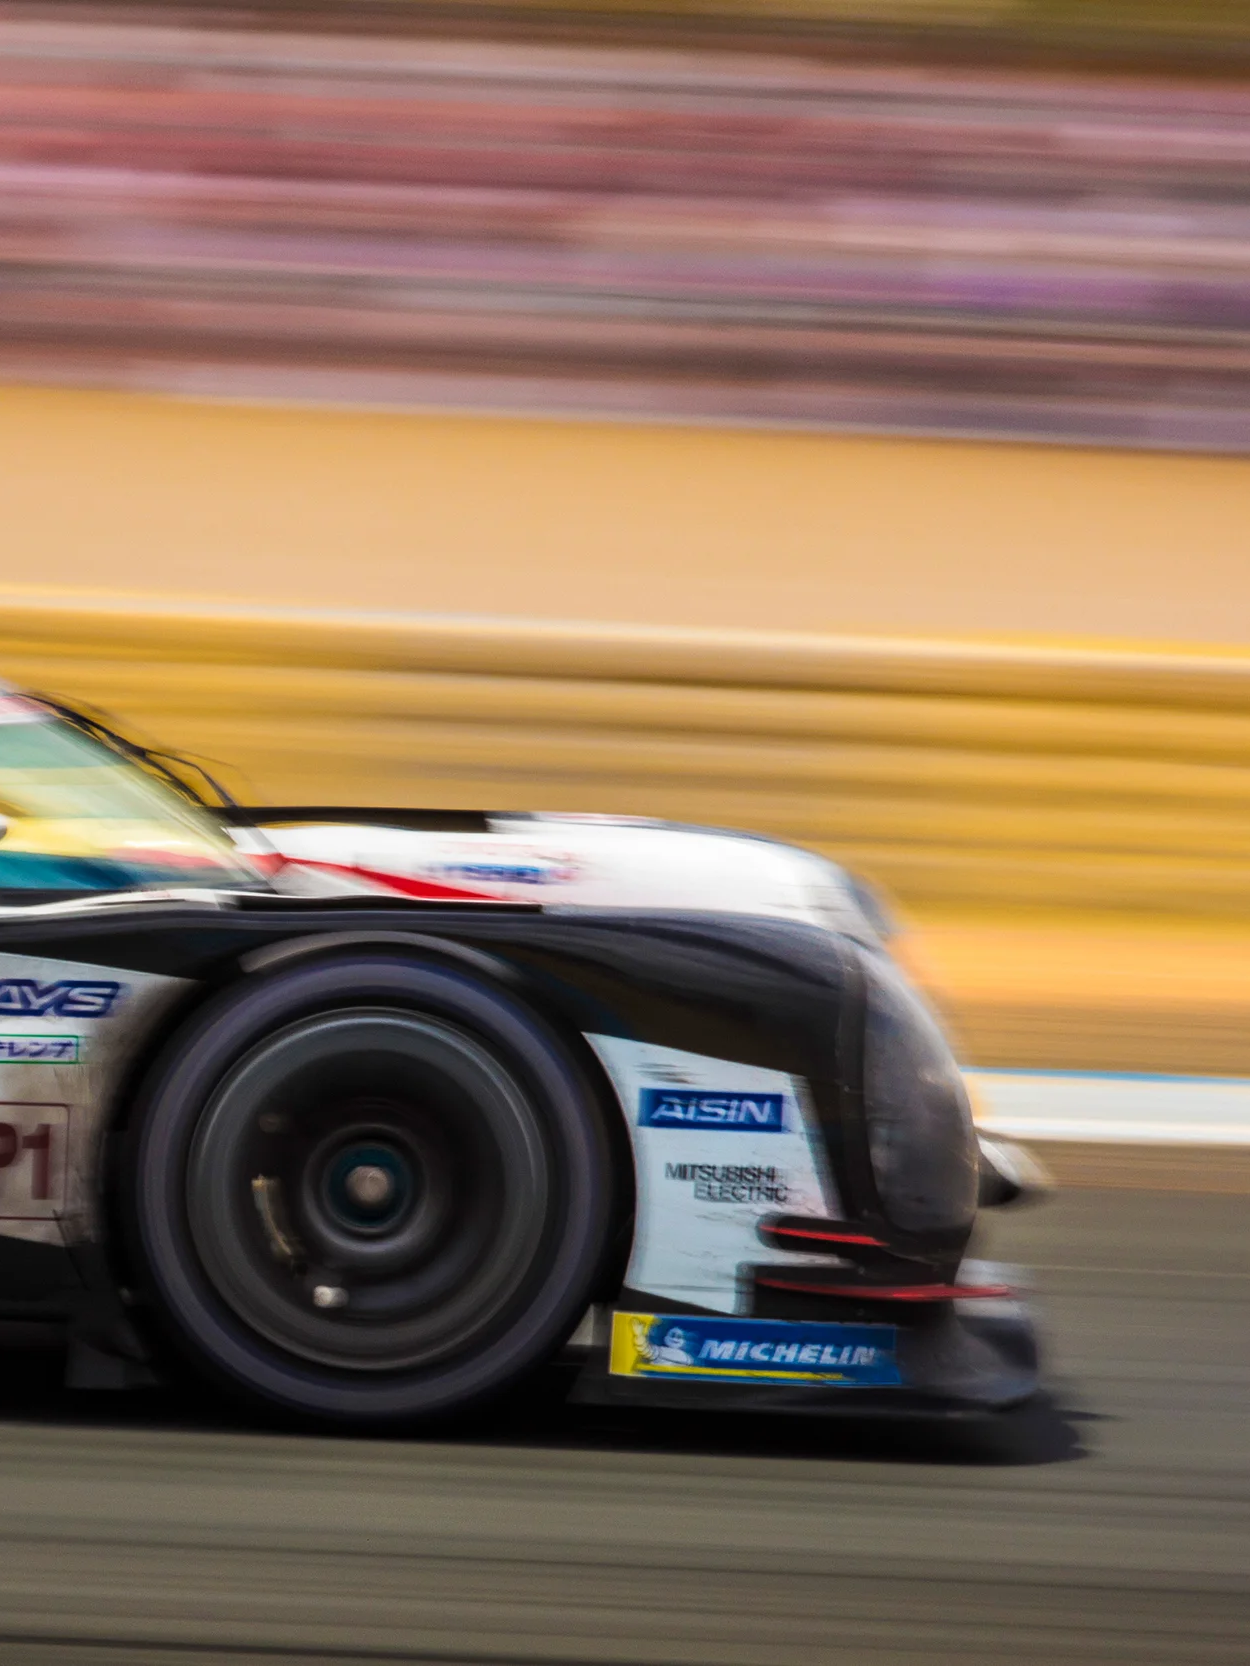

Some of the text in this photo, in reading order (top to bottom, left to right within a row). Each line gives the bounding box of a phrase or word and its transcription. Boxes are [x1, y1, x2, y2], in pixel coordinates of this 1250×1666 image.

[651, 1097, 772, 1123] AISIN
[665, 1163, 777, 1183] MITSUBISHI
[694, 1183, 791, 1204] ELECTRIC
[700, 1339, 877, 1366] MICHELIN
